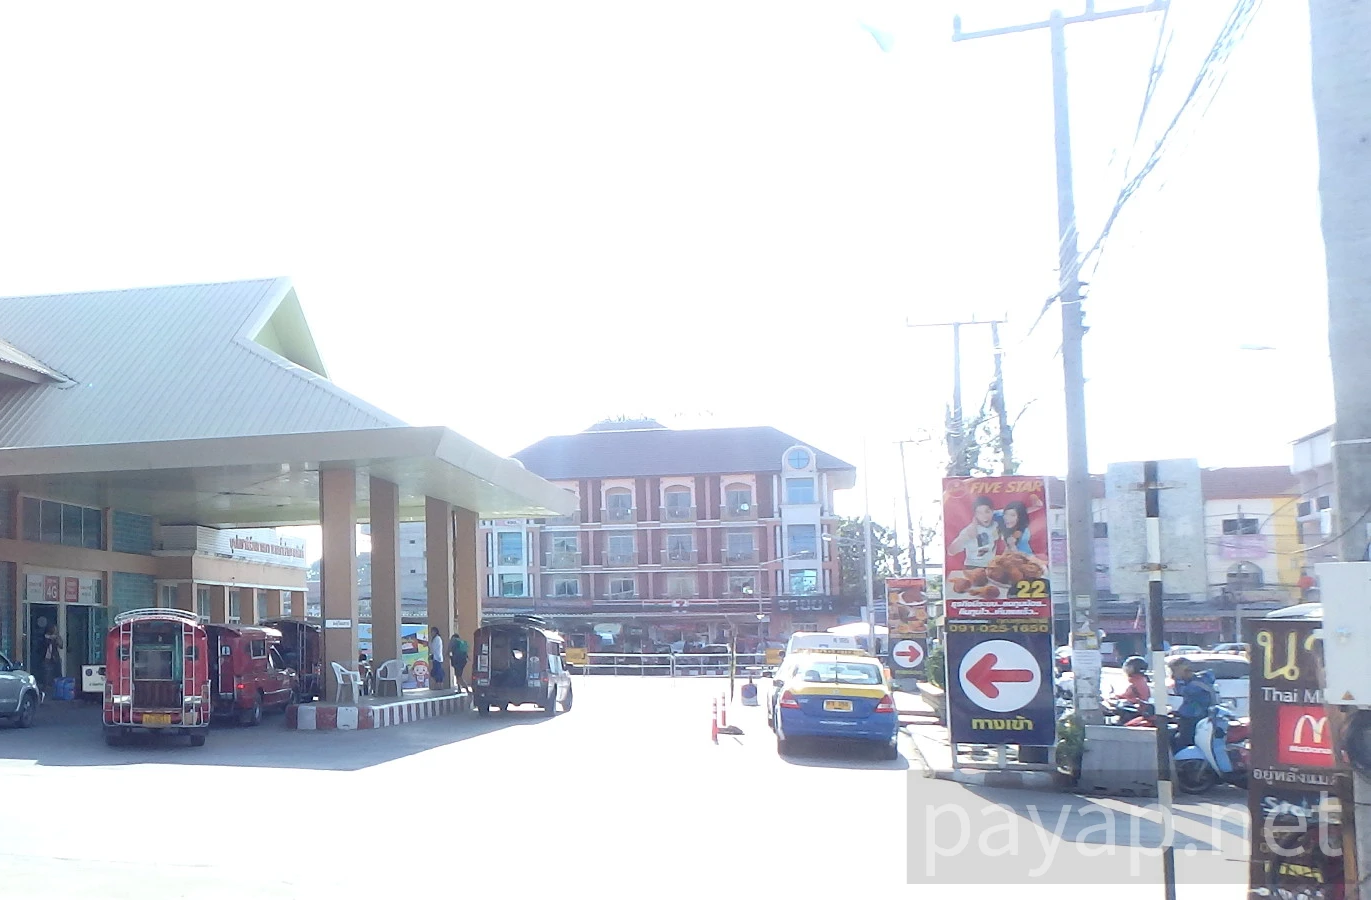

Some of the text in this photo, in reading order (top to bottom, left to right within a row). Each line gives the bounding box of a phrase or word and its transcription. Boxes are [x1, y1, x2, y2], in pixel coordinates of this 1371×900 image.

[970, 480, 1043, 493] FIVE STAR
[46, 585, 58, 599] 4G
[1016, 580, 1046, 598] 22
[1261, 687, 1298, 703] Thai
[971, 716, 1033, 731] ทางเข้า
